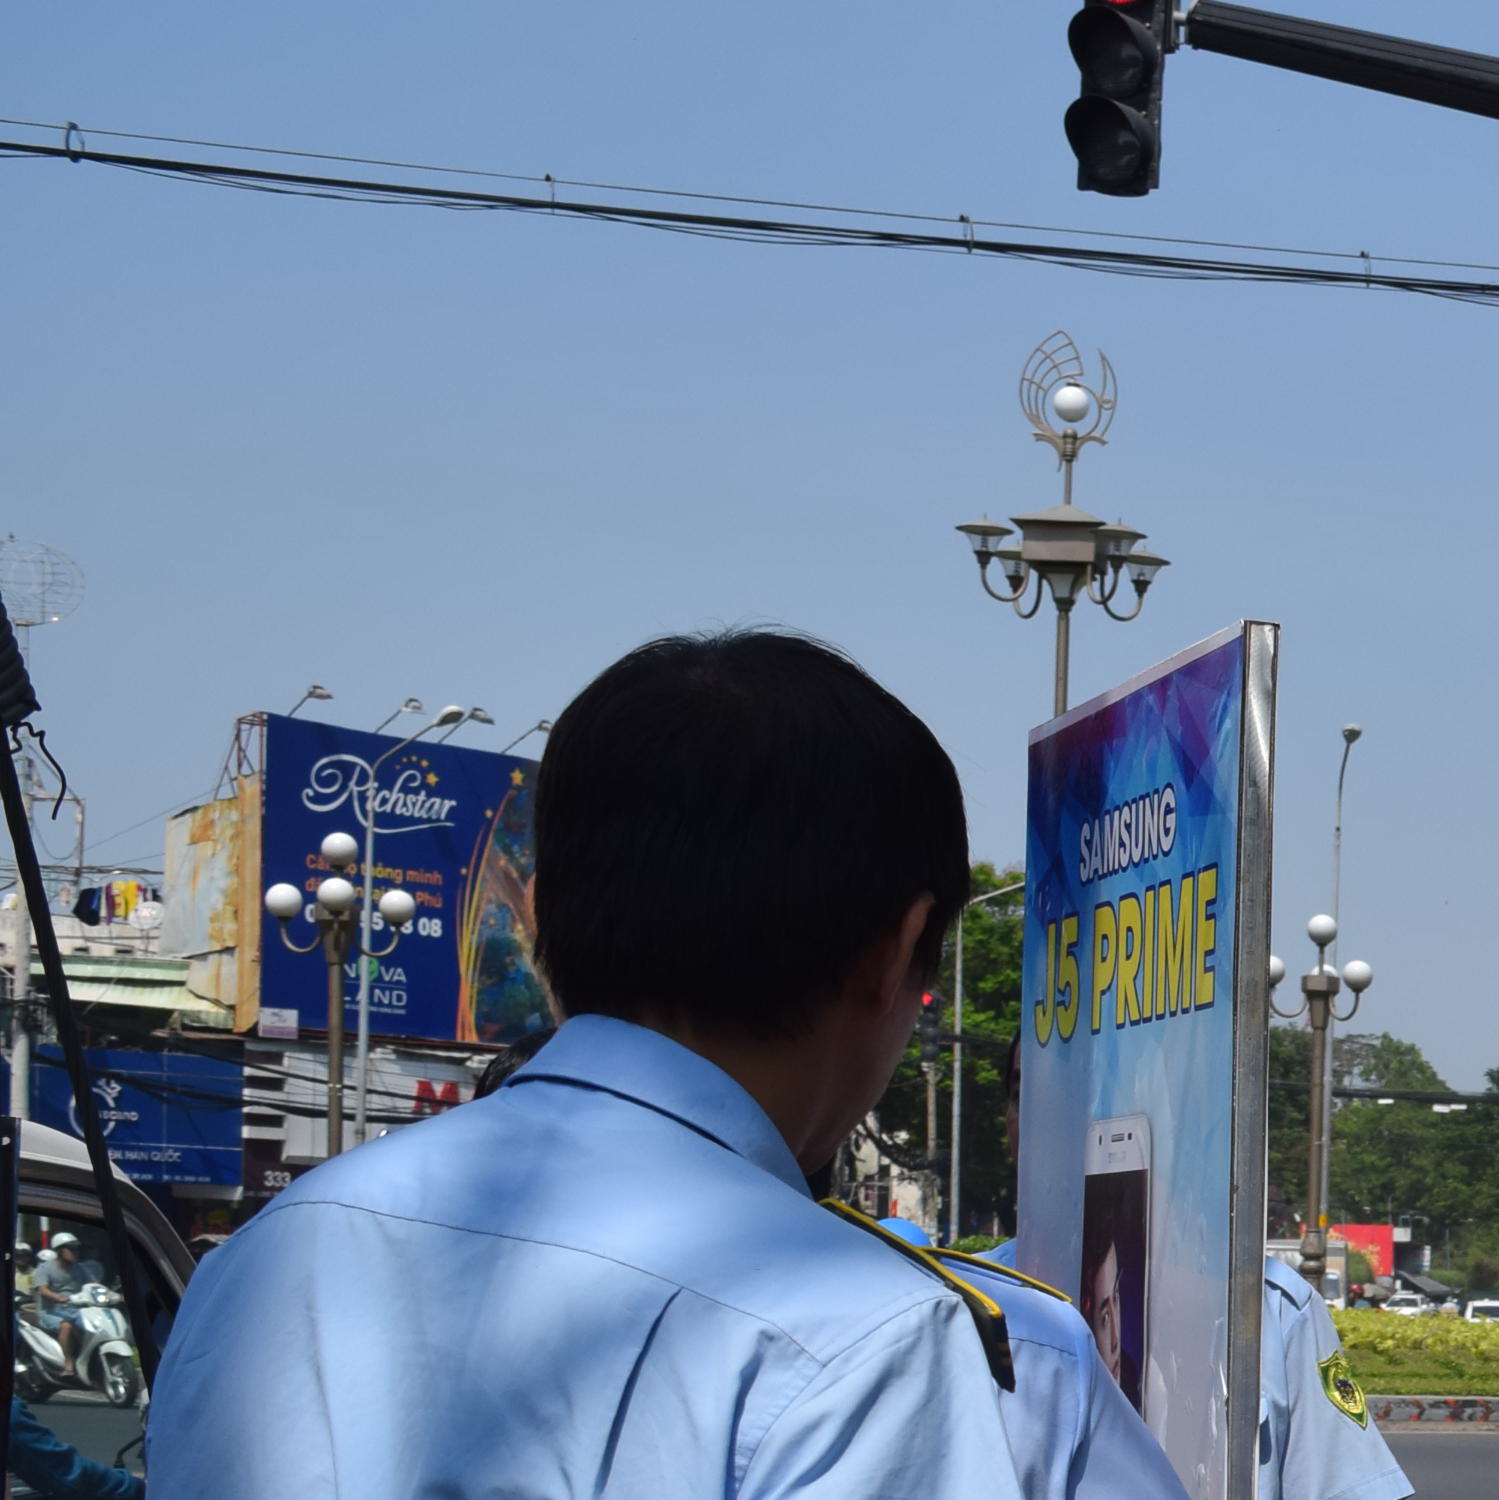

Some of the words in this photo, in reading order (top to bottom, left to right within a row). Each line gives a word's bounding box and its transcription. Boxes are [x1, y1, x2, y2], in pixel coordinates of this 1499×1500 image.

[302, 754, 458, 833] Richstar
[1079, 782, 1177, 883] SAMSUNG
[406, 868, 443, 886] minh
[417, 917, 442, 937] 08
[1034, 914, 1081, 1047] J5
[1091, 865, 1219, 1034] PRIME
